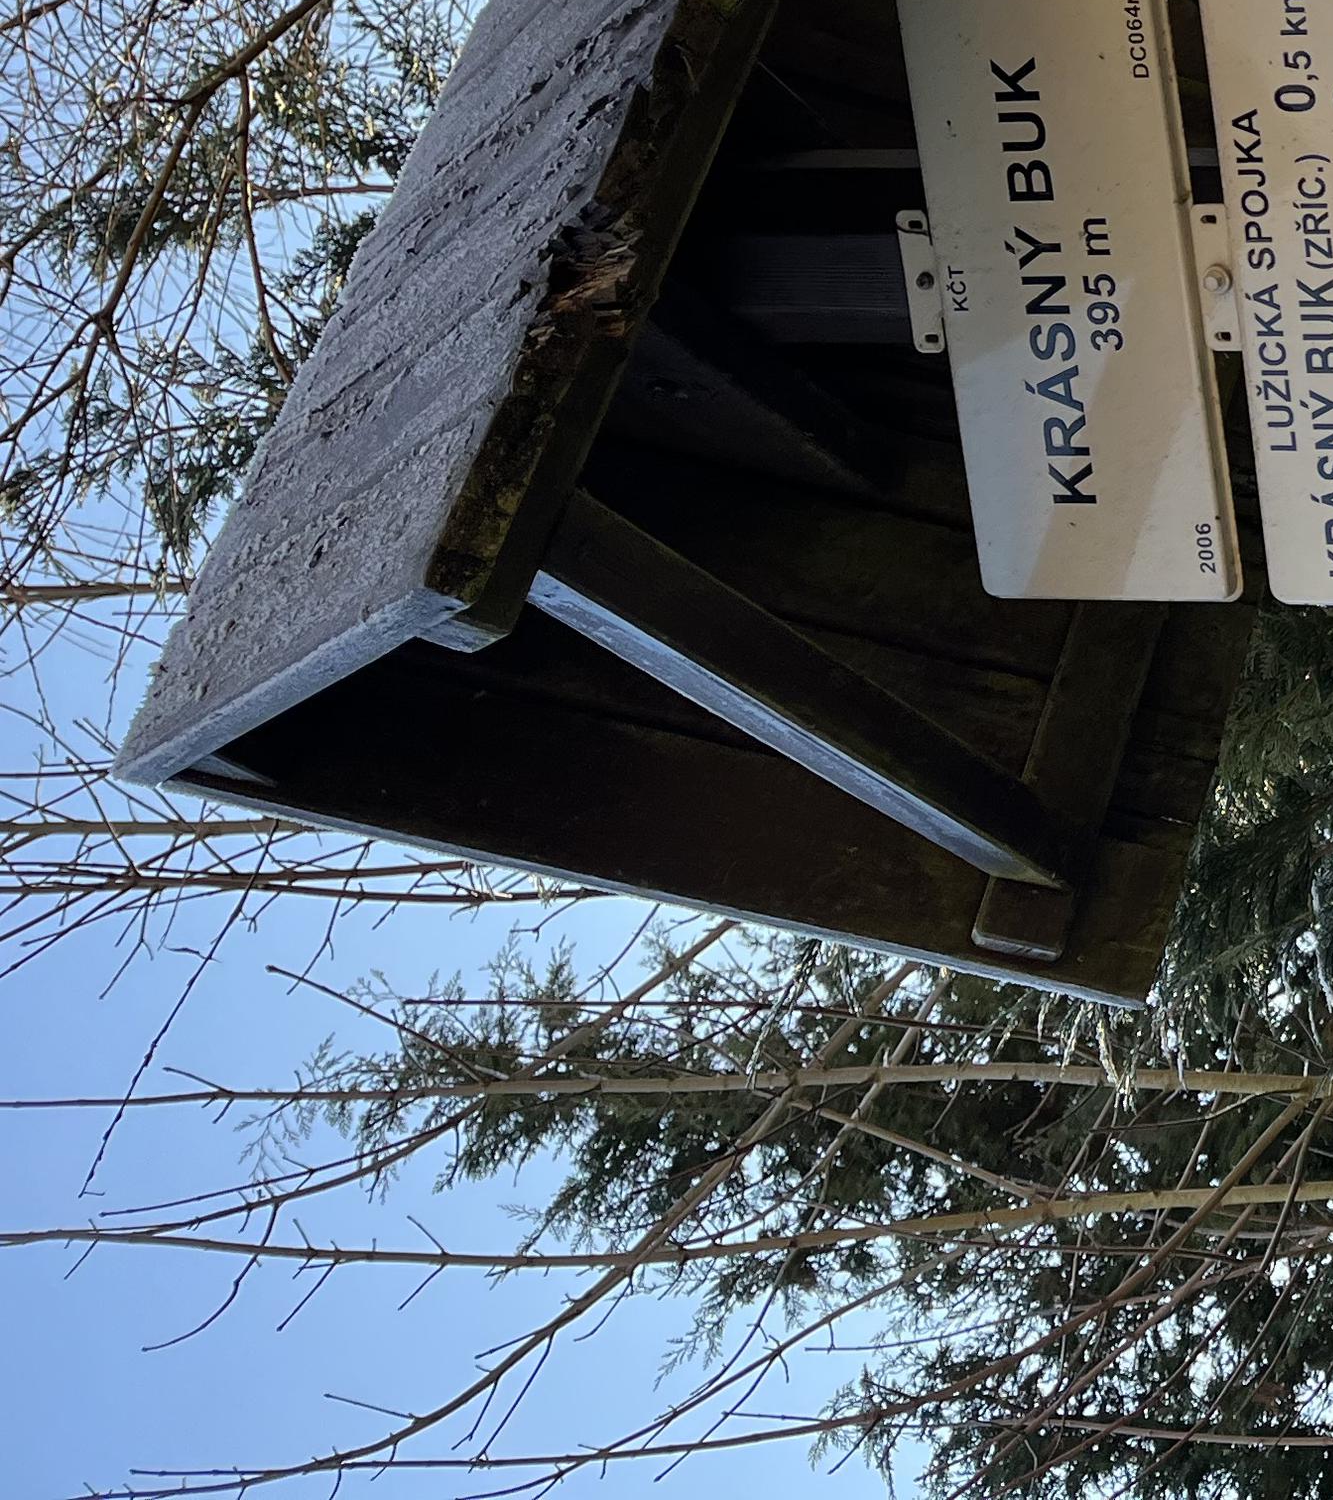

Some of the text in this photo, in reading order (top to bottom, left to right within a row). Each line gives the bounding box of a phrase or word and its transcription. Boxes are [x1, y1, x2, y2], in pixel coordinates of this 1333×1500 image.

[1274, 50, 1319, 113] 0,5
[946, 265, 969, 312] KČT
[989, 57, 1097, 505] KRÁSNÝ BUK
[1081, 217, 1124, 352] 395 m
[1231, 109, 1298, 453] LUŽICKÁ SPOJKA
[1195, 523, 1216, 574] 2006
